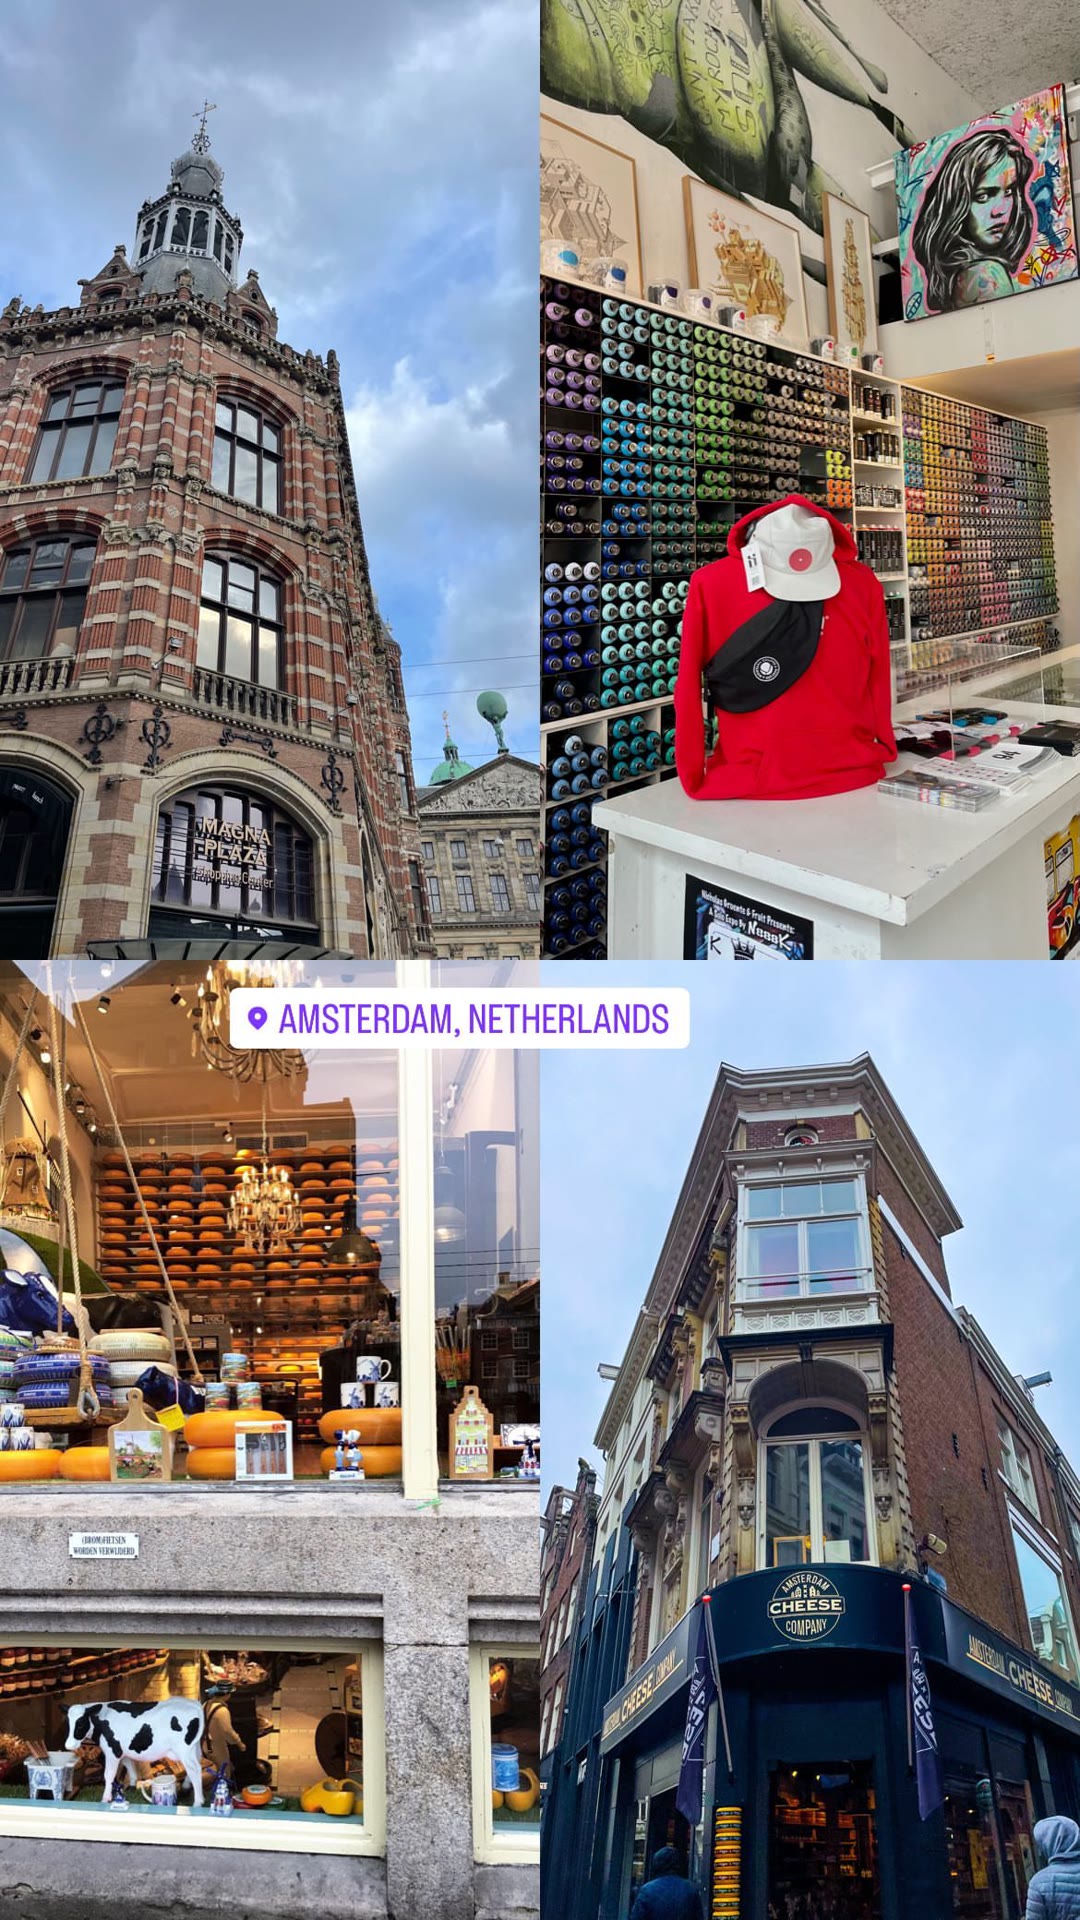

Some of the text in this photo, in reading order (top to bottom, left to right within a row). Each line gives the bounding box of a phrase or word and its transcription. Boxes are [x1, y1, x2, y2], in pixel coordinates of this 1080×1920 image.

[201, 816, 272, 846] MAGNA
[204, 839, 268, 866] PLAZA
[196, 865, 274, 889] Shopping Center
[708, 907, 714, 916] A
[752, 909, 767, 923] Fruit
[710, 936, 721, 955] K
[781, 1574, 831, 1593] AMSTERDAM
[769, 1599, 842, 1615] CHEESE
[785, 1619, 828, 1636] COMPANY
[1009, 1660, 1055, 1706] CHEESE
[621, 1672, 655, 1722] CHEESE
